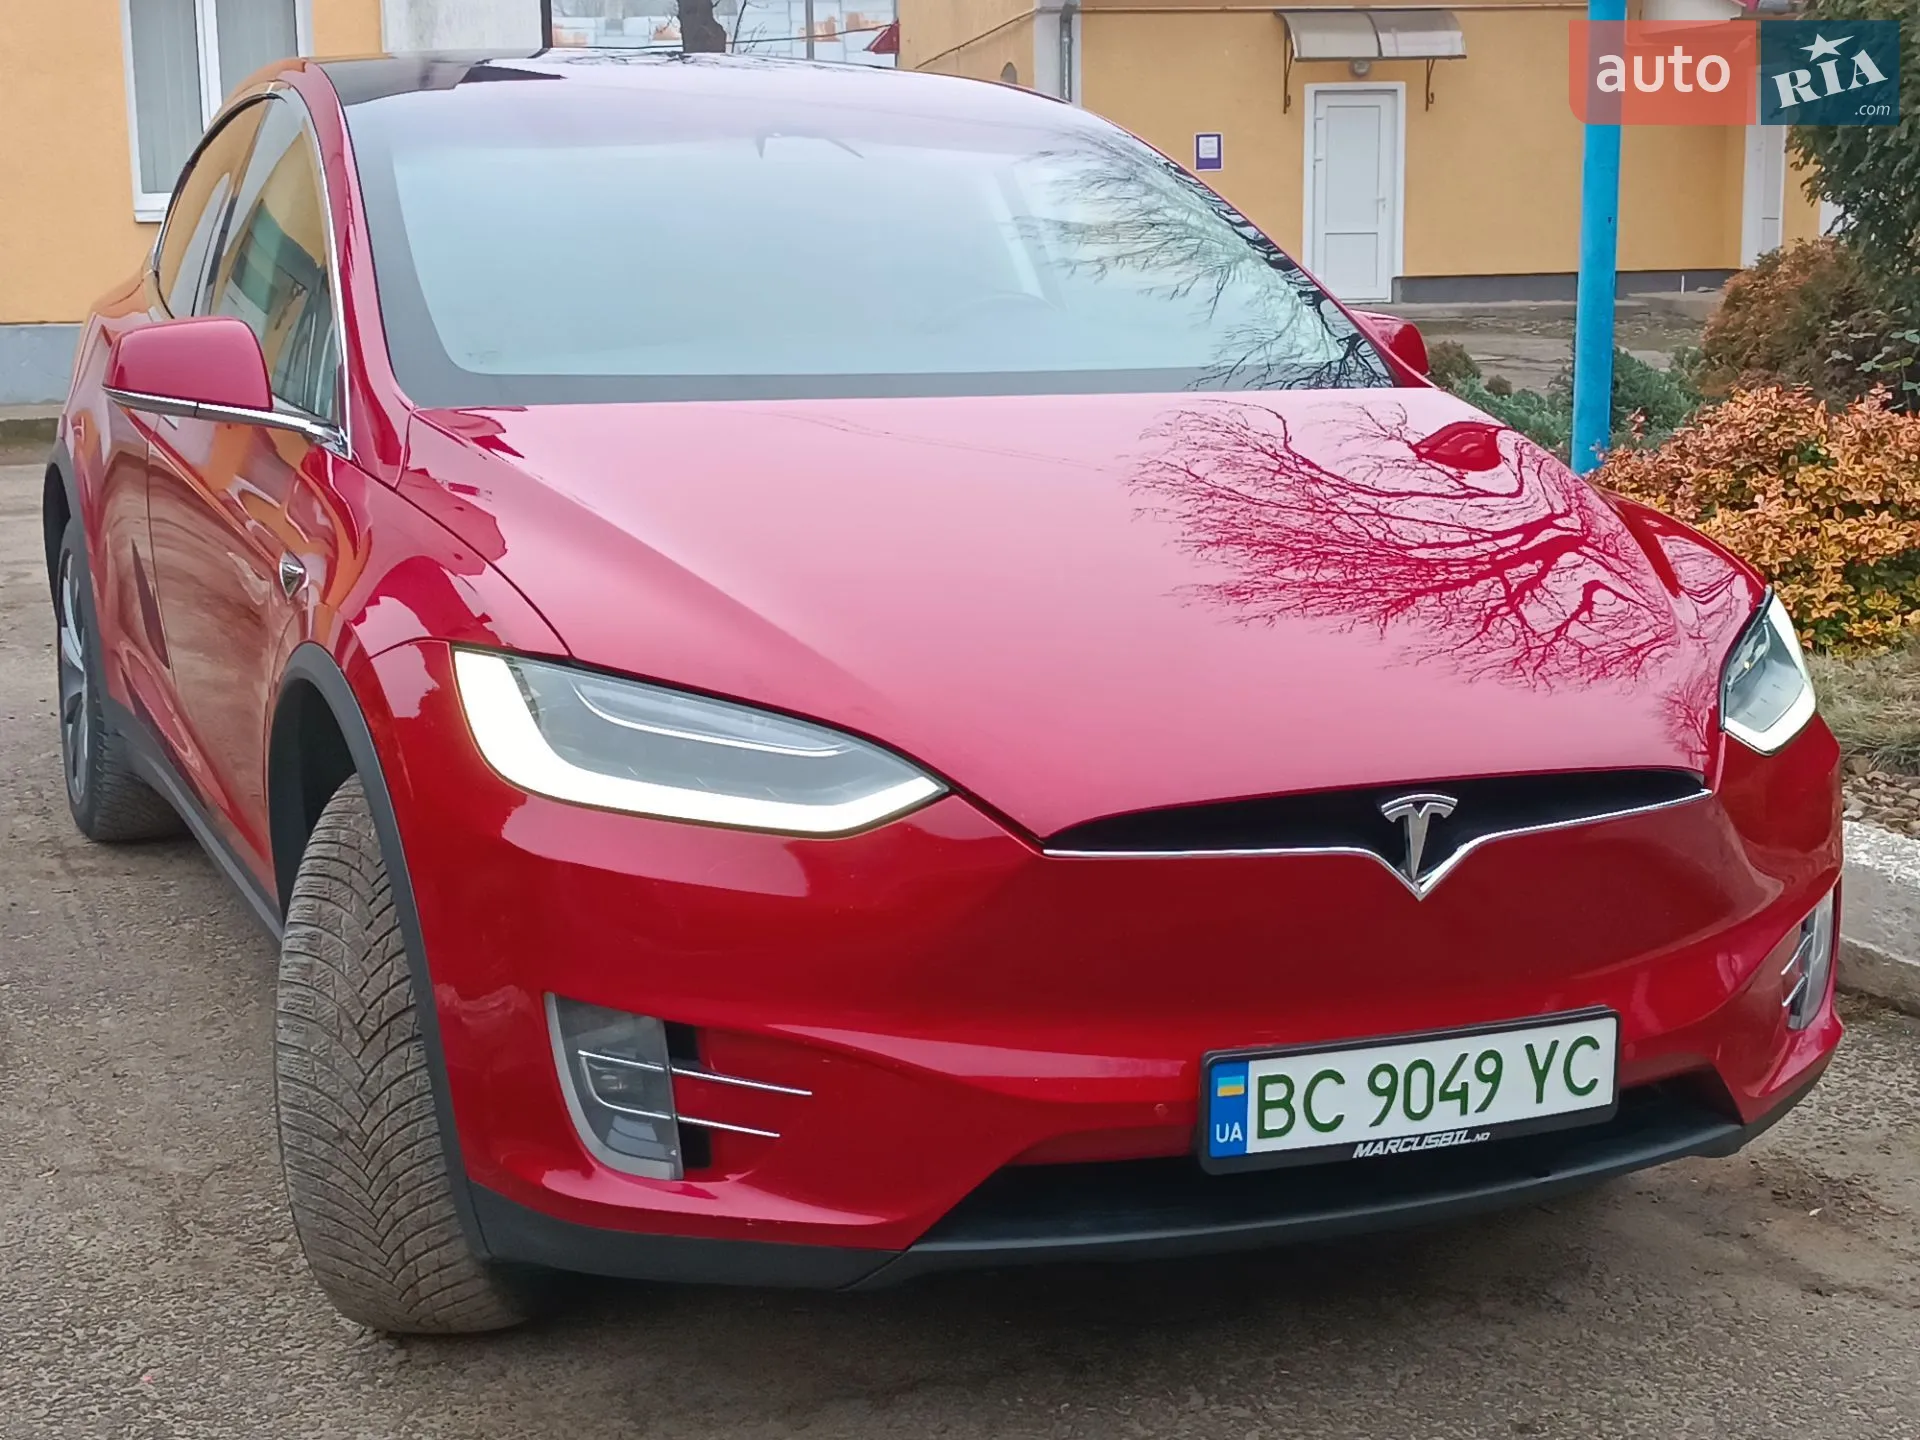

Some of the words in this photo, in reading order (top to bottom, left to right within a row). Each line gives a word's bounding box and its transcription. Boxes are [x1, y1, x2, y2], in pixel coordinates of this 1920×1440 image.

[1257, 1069, 1345, 1139] BC
[1367, 1049, 1503, 1128] 9049
[1525, 1035, 1600, 1104] YC
[1215, 1121, 1243, 1144] UA
